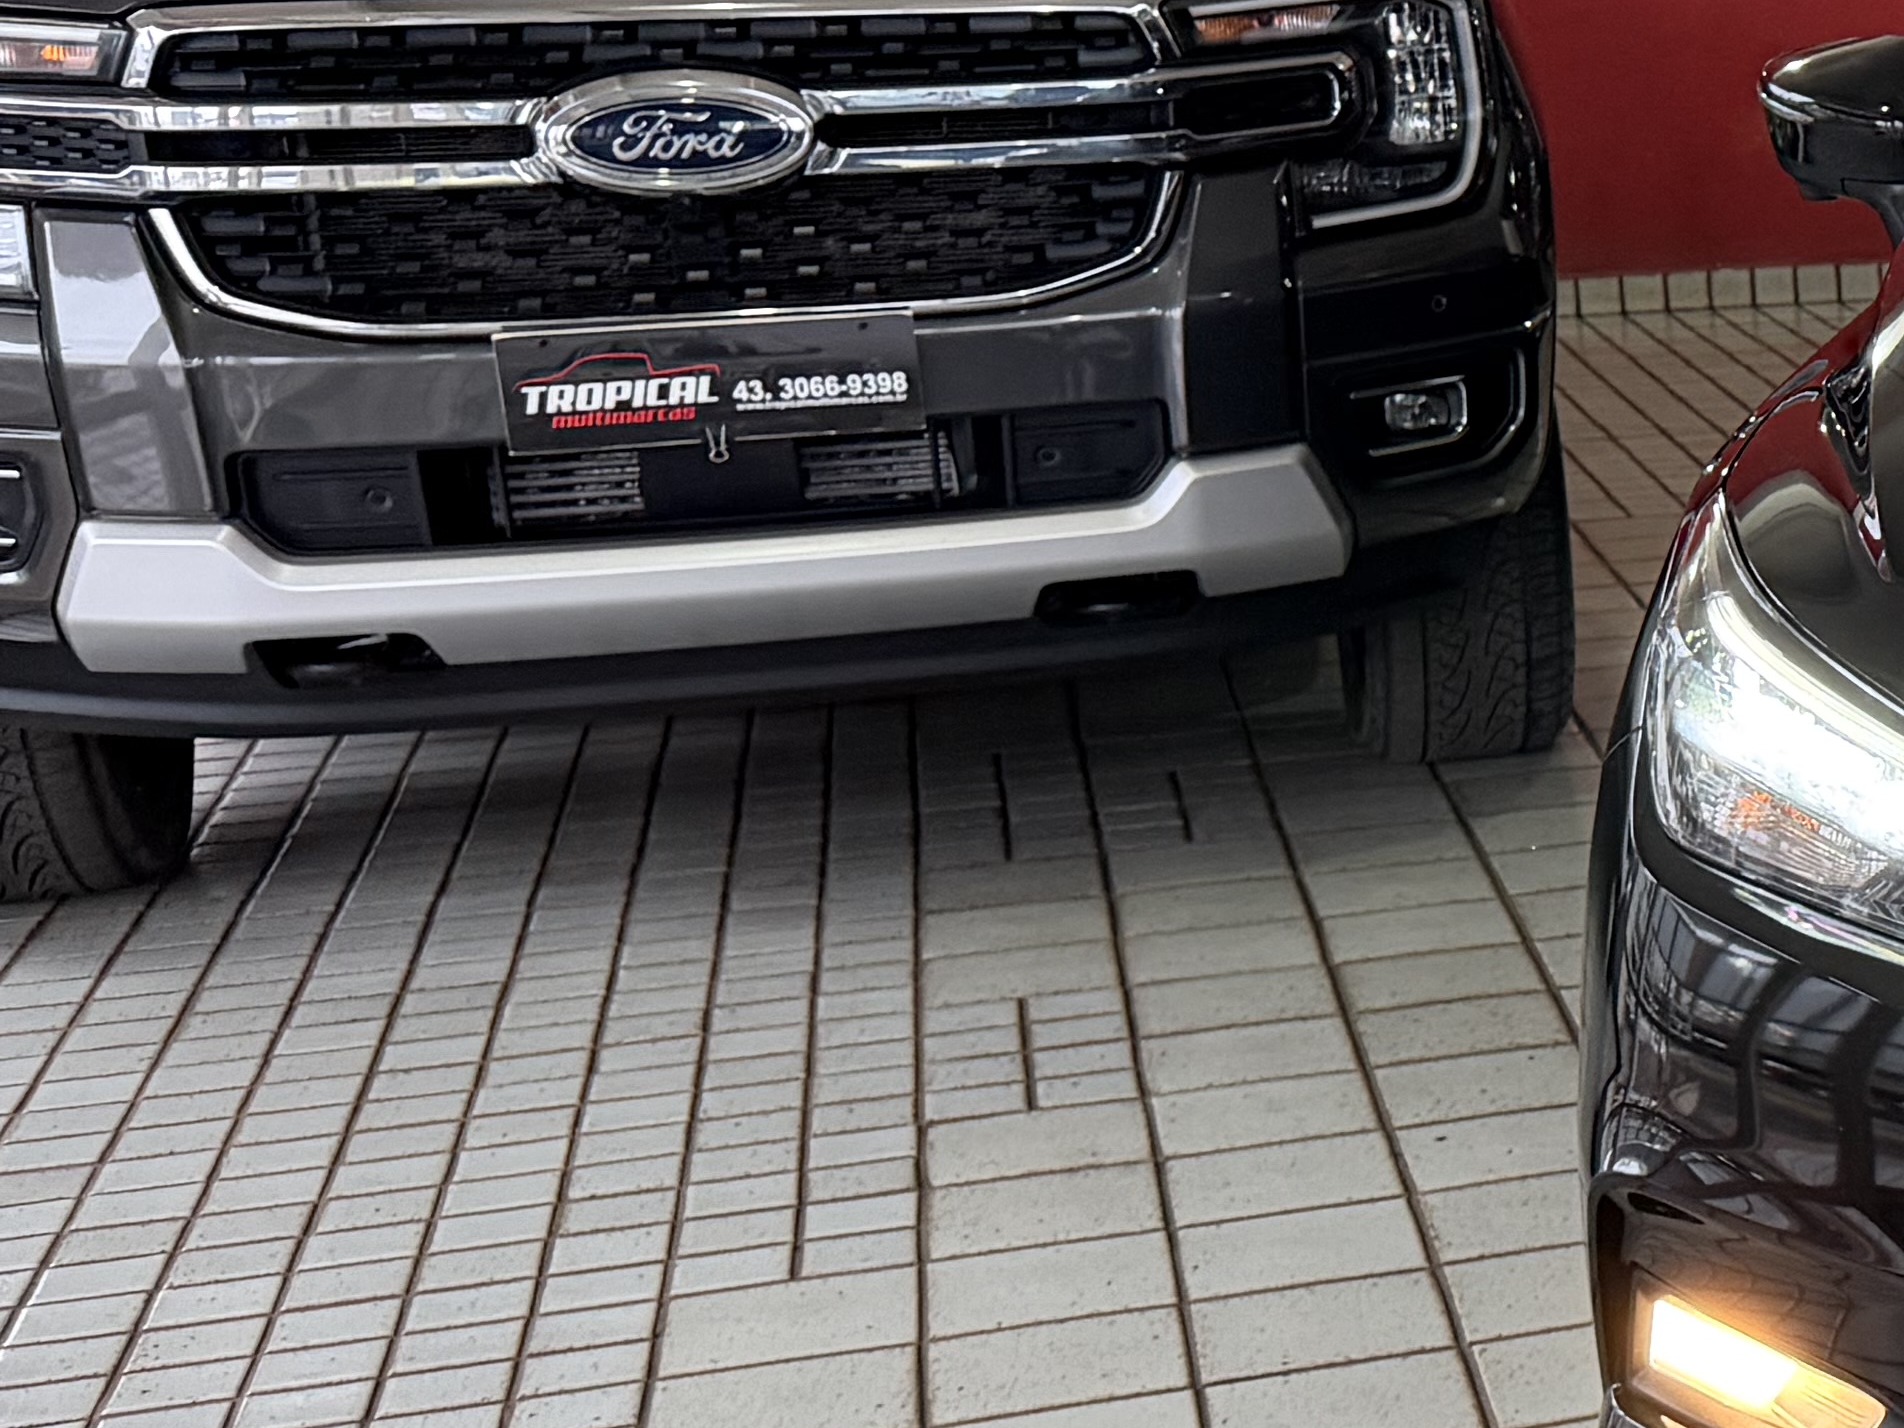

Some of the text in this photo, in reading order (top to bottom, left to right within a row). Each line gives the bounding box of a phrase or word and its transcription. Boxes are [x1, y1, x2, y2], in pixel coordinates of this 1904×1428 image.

[611, 109, 745, 161] Ford
[520, 374, 720, 416] TROPICAL
[778, 370, 909, 401] 3066-9398
[551, 406, 697, 430] multimarcas
